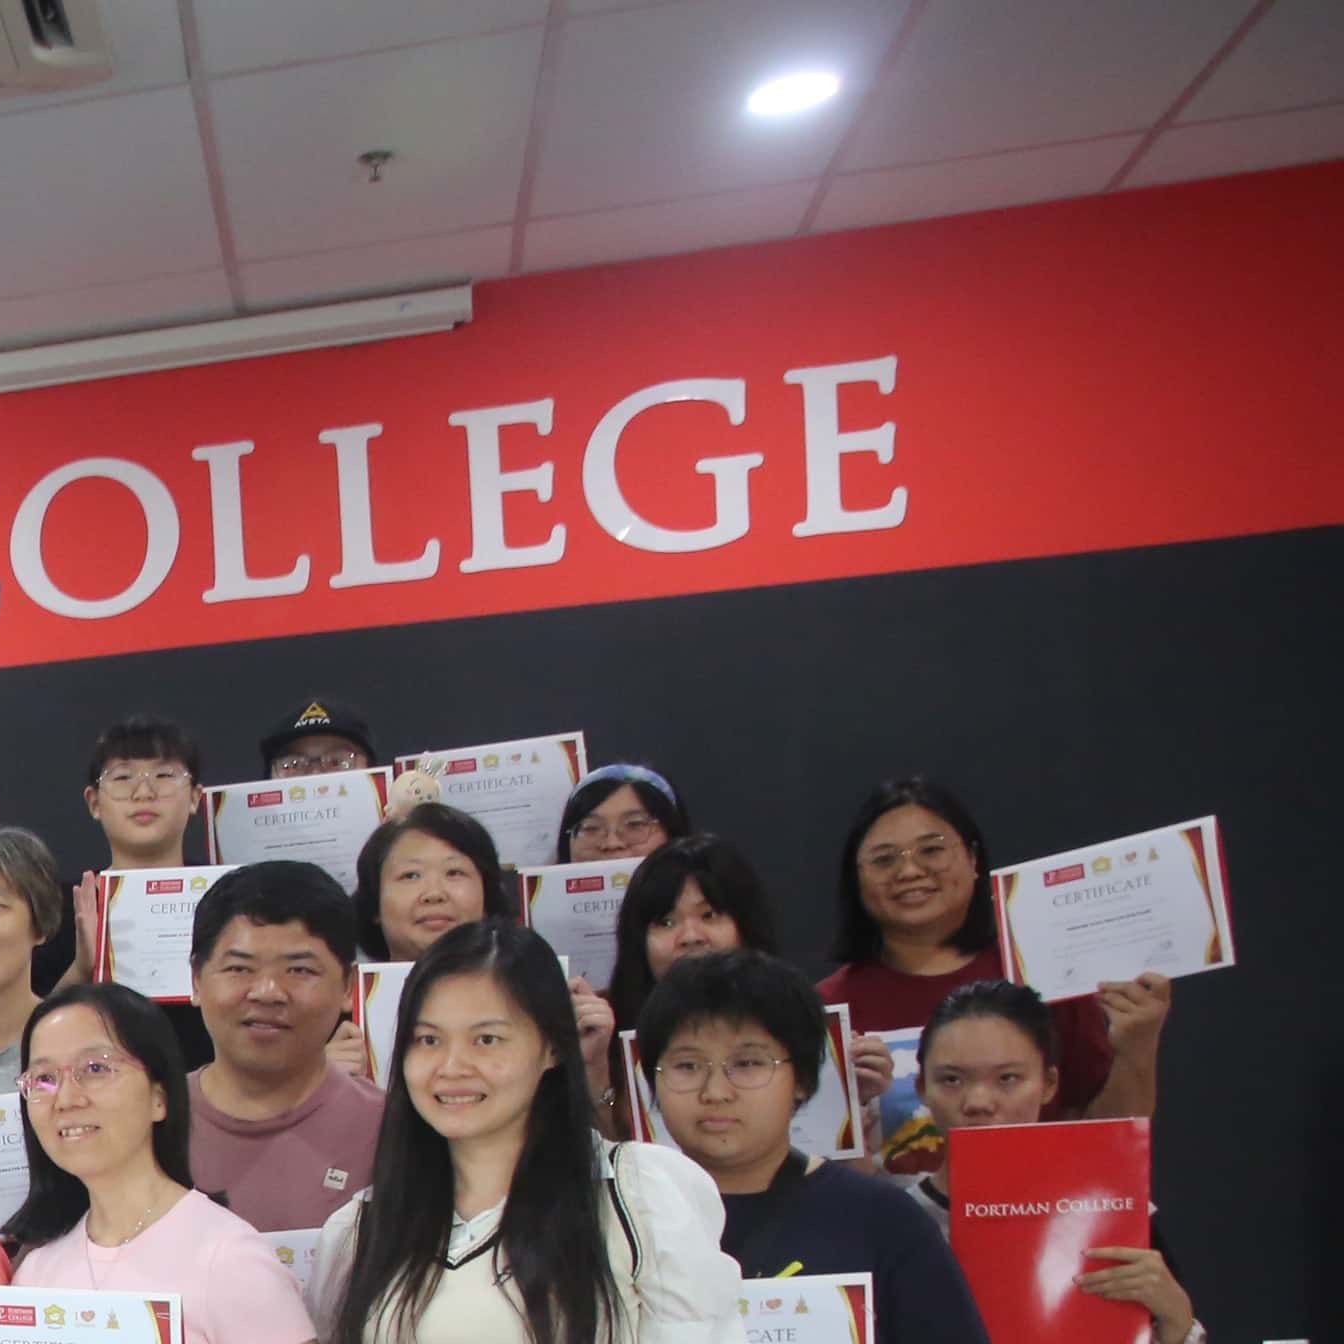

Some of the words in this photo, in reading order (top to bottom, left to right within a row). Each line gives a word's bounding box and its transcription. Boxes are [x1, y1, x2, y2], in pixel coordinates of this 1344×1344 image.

[254, 807, 341, 827] CERTIFICATE
[1053, 874, 1154, 909] CERTIFICATE
[964, 1200, 1050, 1218] PORTMAN
[1055, 1196, 1135, 1215] COLLEGE
